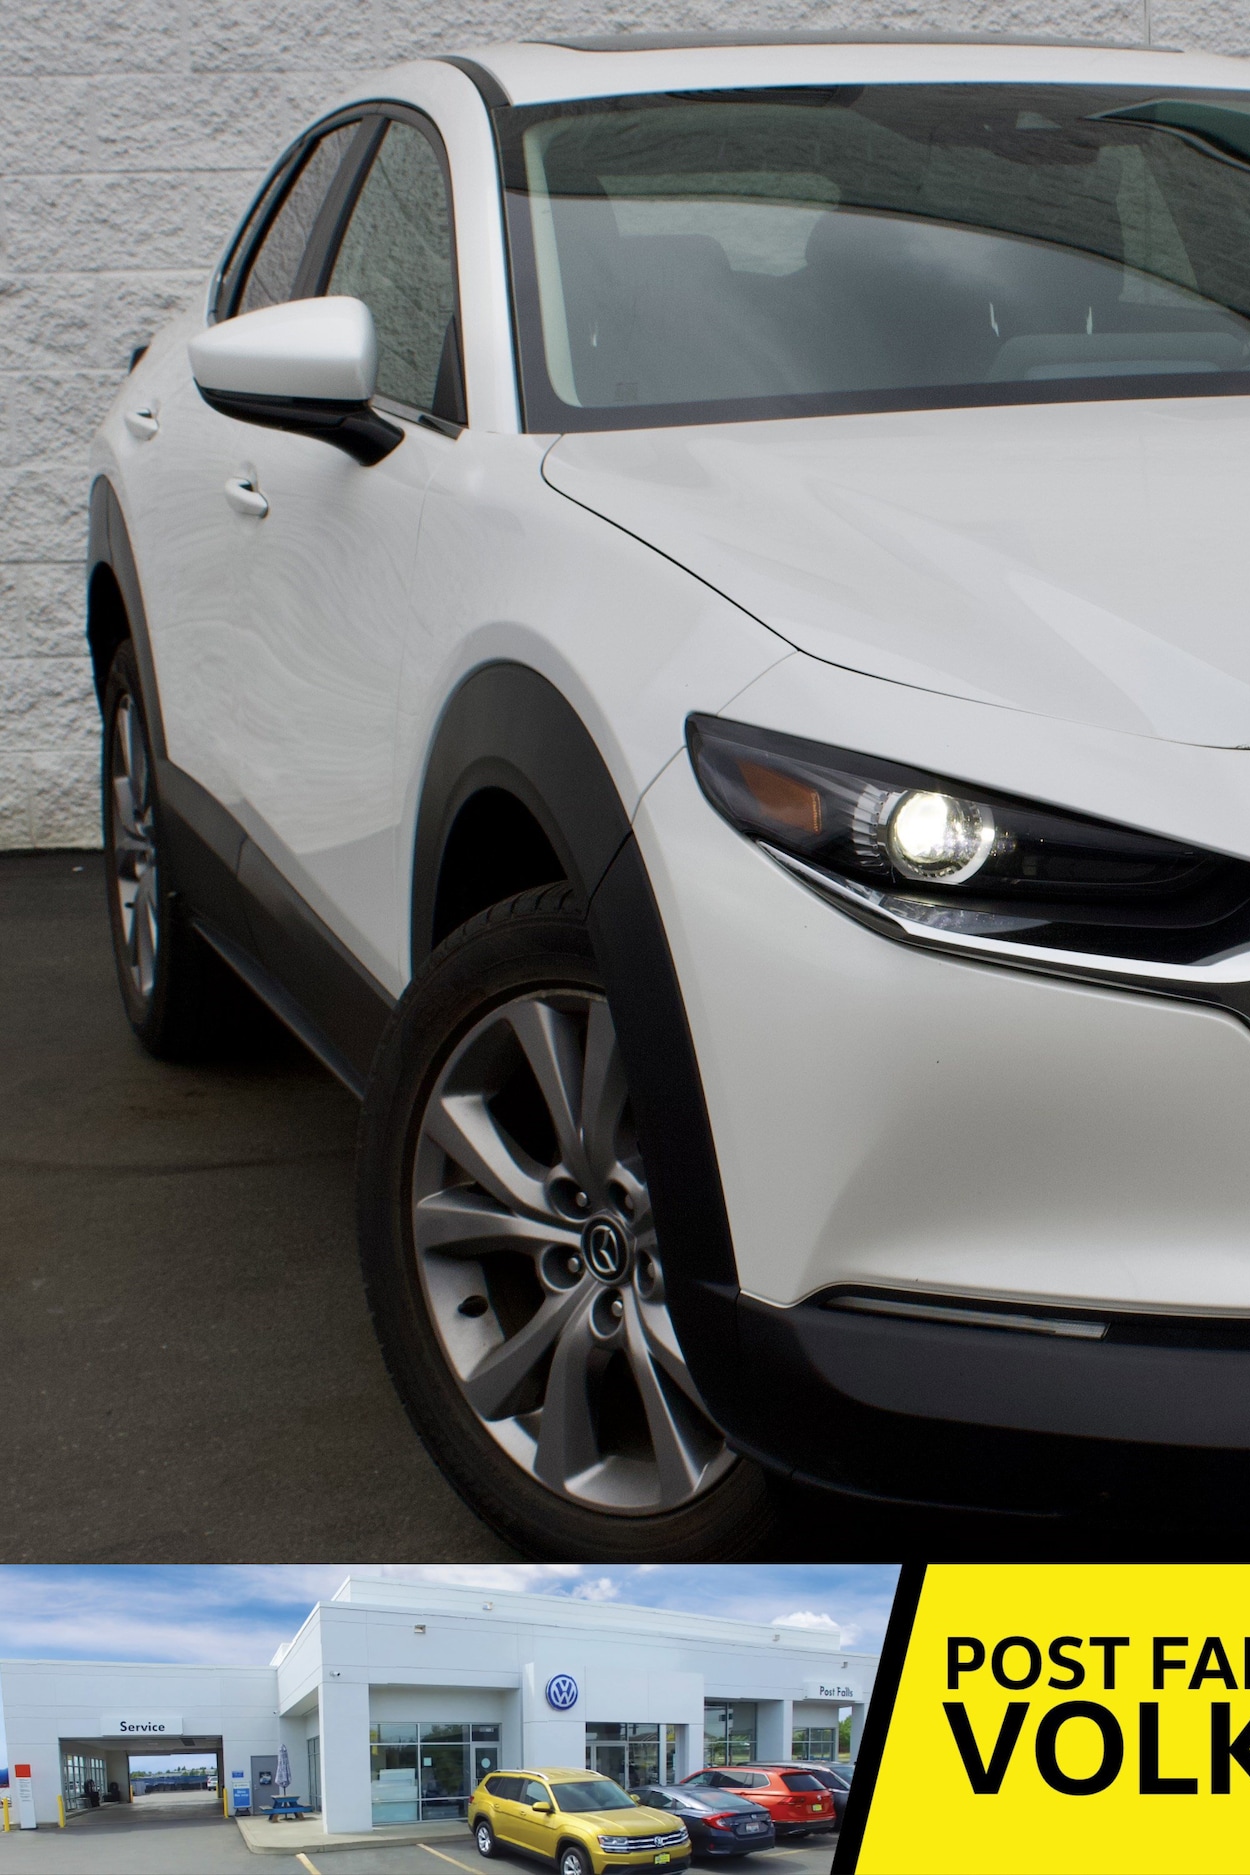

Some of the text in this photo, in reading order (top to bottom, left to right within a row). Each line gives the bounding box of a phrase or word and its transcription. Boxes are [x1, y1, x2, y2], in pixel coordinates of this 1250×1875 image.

[819, 1685, 854, 1698] Post Falls
[119, 1720, 166, 1732] Service
